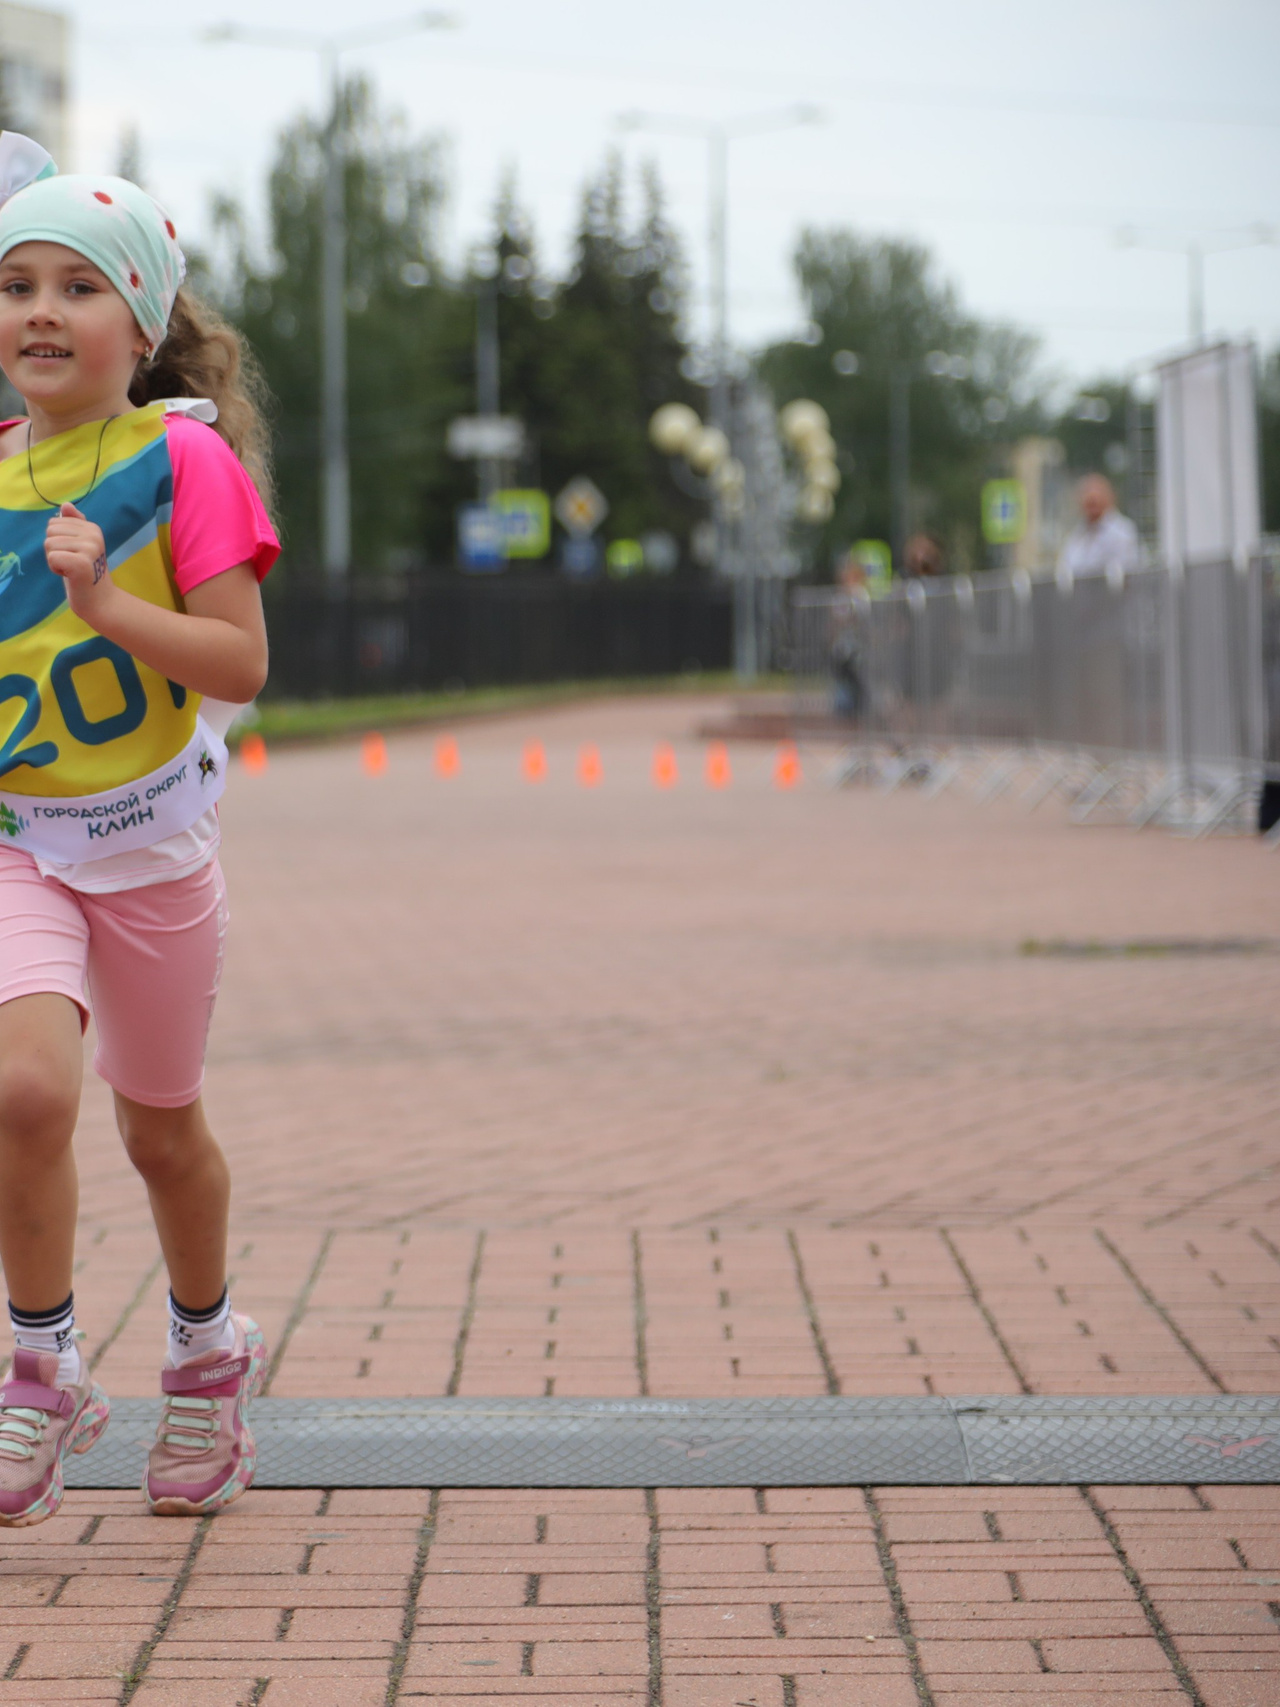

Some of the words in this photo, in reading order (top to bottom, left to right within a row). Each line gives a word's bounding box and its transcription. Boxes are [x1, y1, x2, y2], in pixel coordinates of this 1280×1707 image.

[33, 792, 140, 818] ГОРОДСКОЙ
[145, 764, 188, 800] ОКРУГ
[87, 806, 155, 839] КЛИН
[200, 1361, 242, 1381] INDIGO
